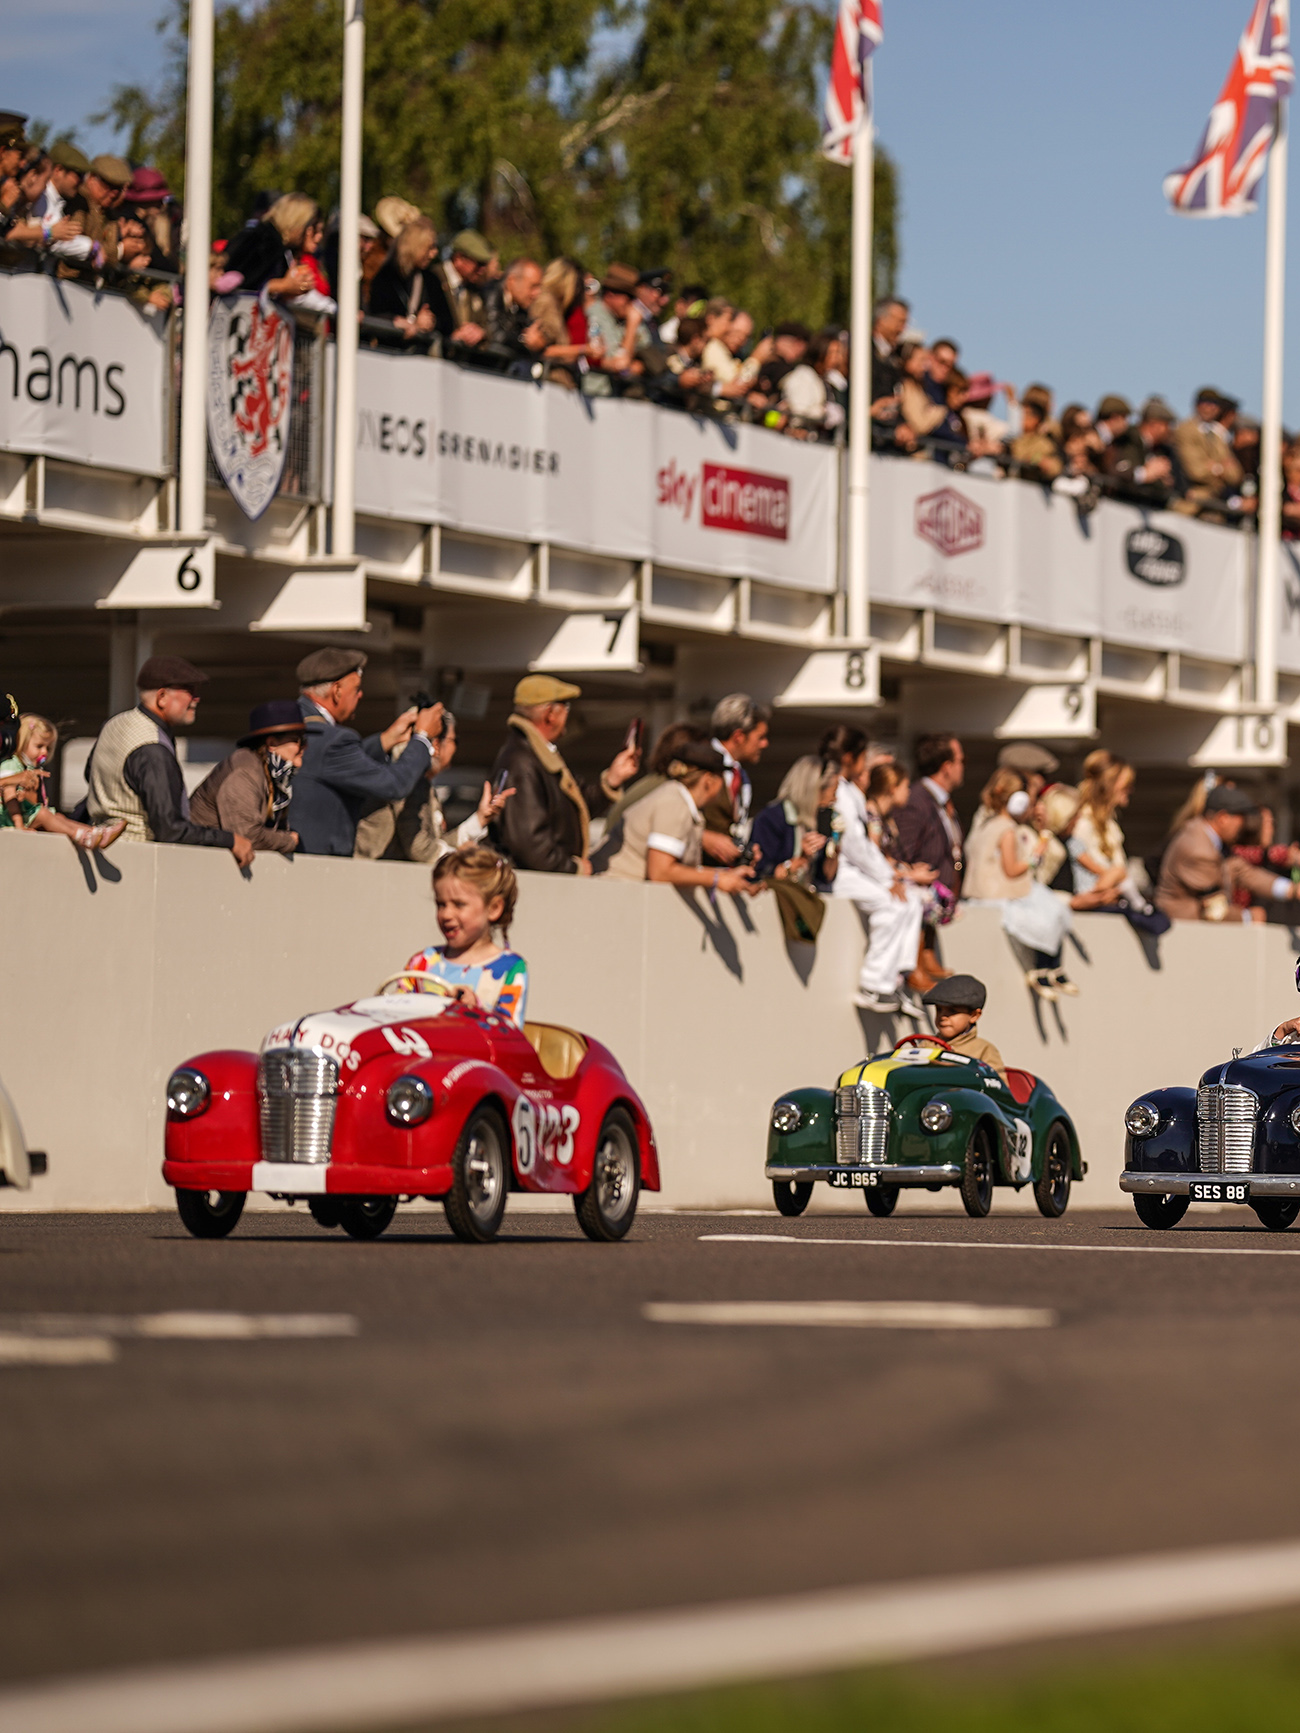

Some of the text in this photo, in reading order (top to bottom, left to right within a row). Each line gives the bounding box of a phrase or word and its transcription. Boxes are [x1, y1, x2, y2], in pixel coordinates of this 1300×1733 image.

[177, 548, 201, 591] 6
[602, 610, 625, 653] 7
[845, 650, 866, 690] 8
[1063, 685, 1083, 721] 9
[833, 1172, 877, 1186] JC 1965
[1194, 1184, 1245, 1200] SES 88
